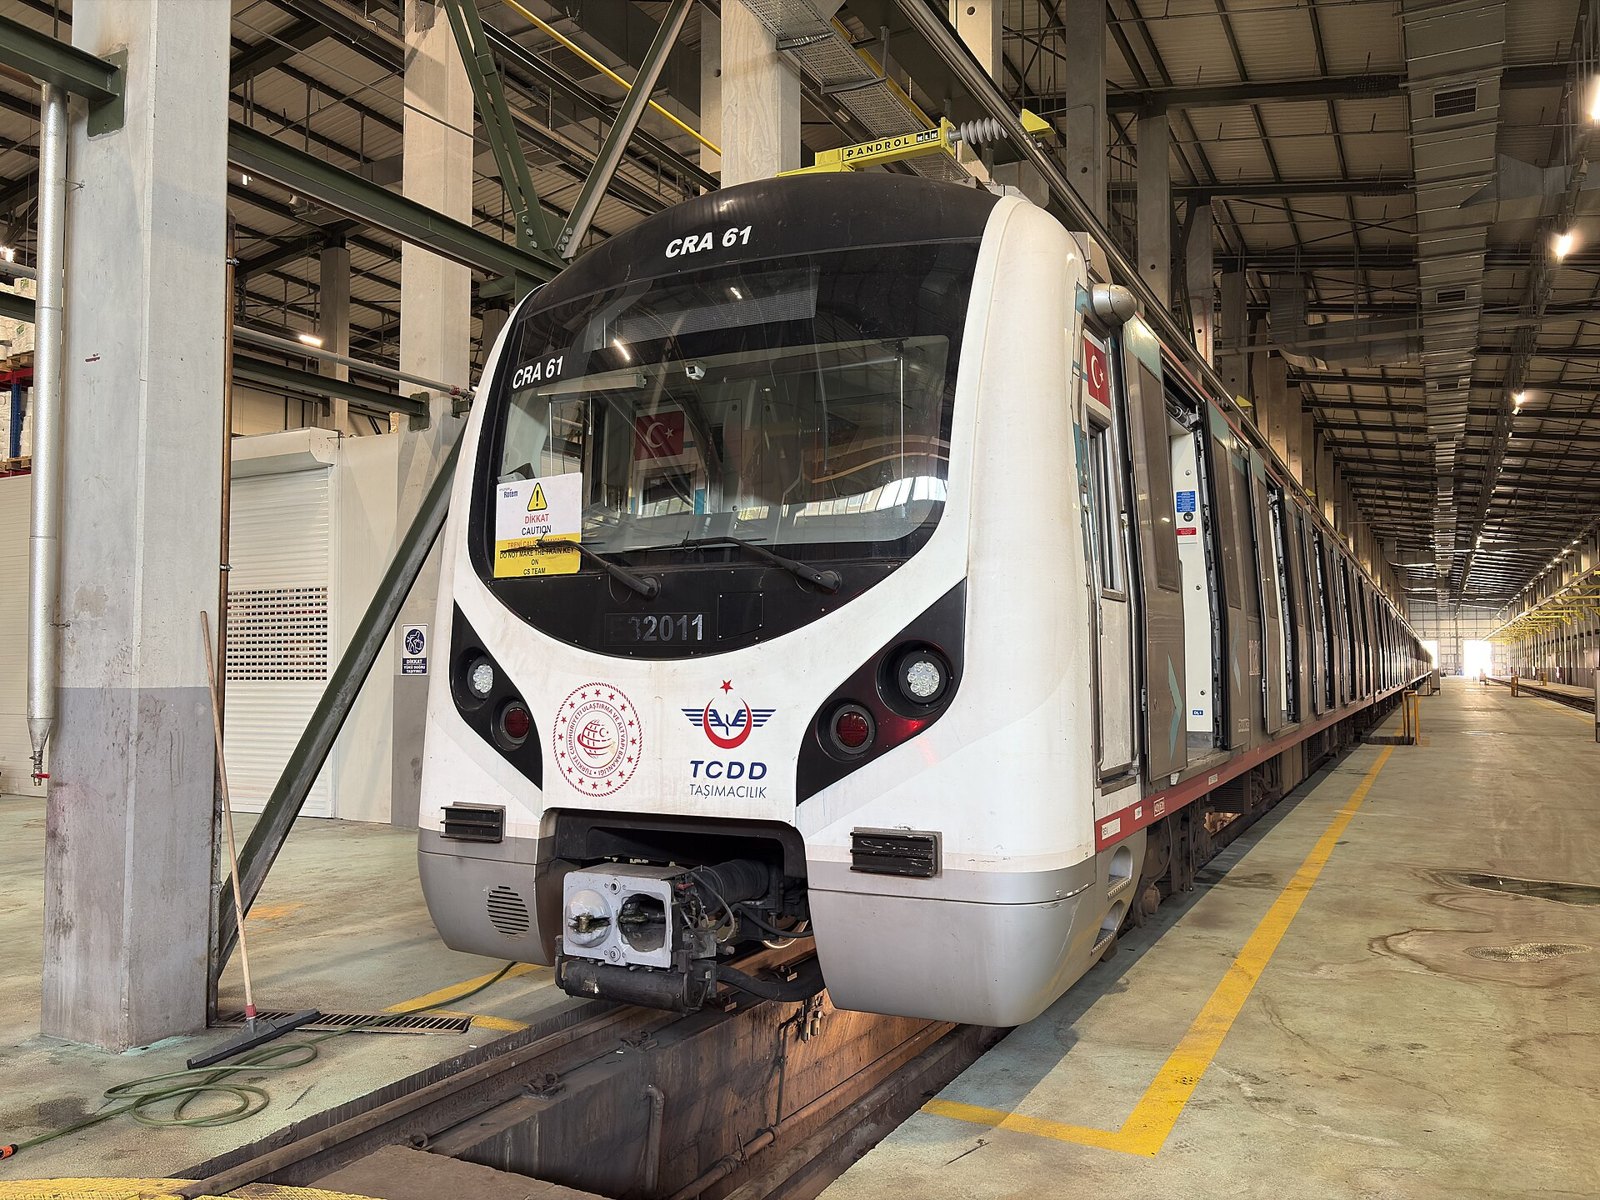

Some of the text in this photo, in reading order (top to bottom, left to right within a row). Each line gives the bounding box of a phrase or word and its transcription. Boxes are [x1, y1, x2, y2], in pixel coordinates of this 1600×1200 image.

[846, 138, 910, 158] PANDROL
[665, 225, 753, 259] CRA 61
[512, 355, 564, 389] CRA 61
[524, 513, 550, 524] DİKKAT
[521, 525, 552, 536] CAUTION
[500, 551, 507, 559] DO
[508, 550, 519, 558] NOT
[519, 549, 534, 557] MAKE
[535, 548, 545, 556] THE
[563, 545, 575, 554] KEY
[531, 558, 539, 566] ON
[531, 567, 546, 575] TEAM
[581, 702, 613, 714] ULAŞTIRMA
[612, 712, 621, 722] VE
[617, 722, 626, 750] ALTYAPI
[689, 760, 768, 780] TCDD
[689, 783, 768, 800] TAŞIMACILIK
